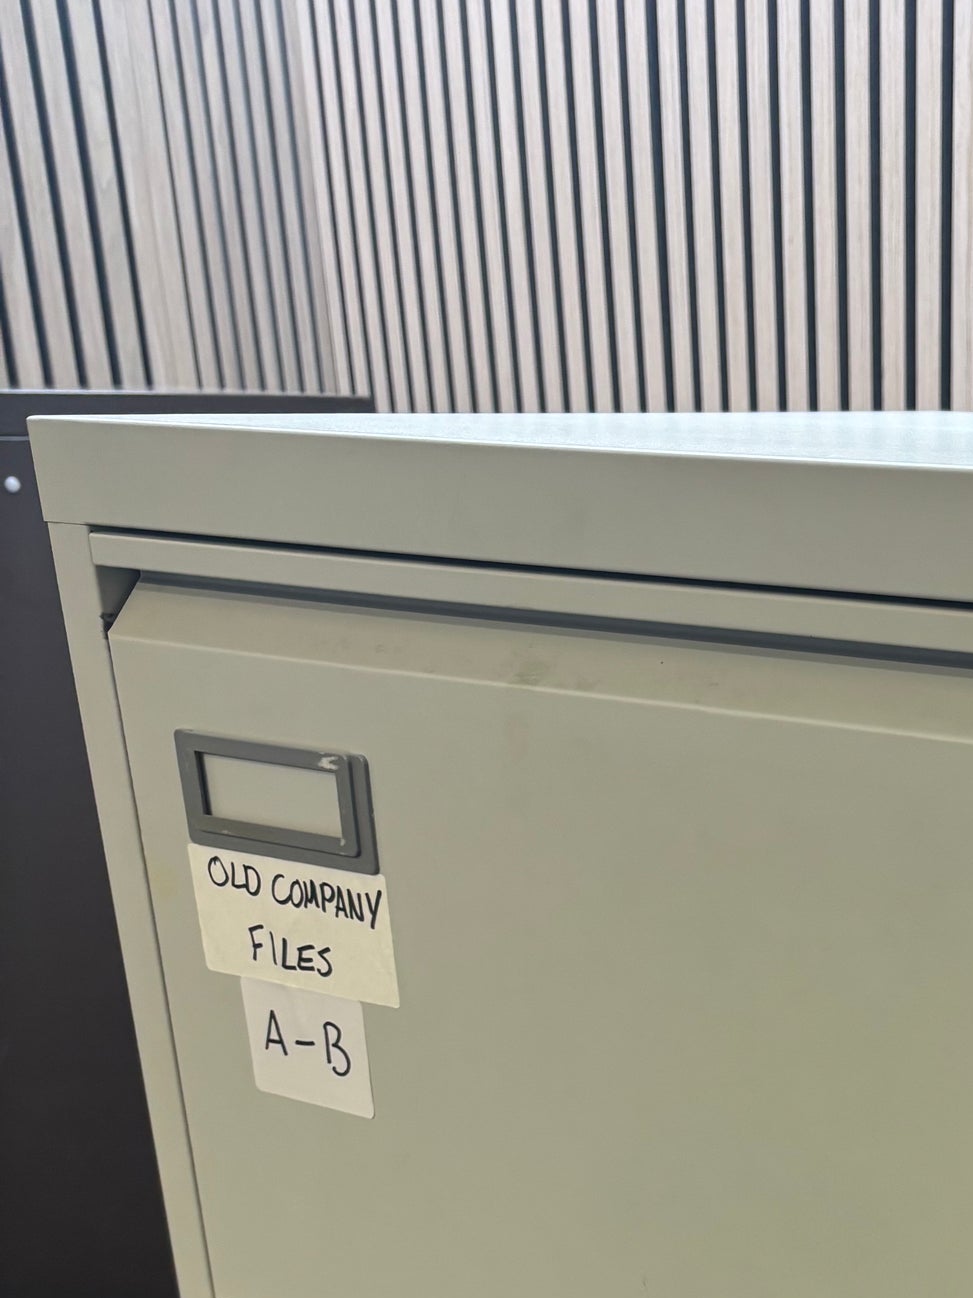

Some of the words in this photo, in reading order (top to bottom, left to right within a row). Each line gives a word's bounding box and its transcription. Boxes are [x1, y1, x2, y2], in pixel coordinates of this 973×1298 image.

[207, 855, 261, 897] OLD
[271, 873, 382, 930] COMPANY
[247, 924, 333, 977] FILES
